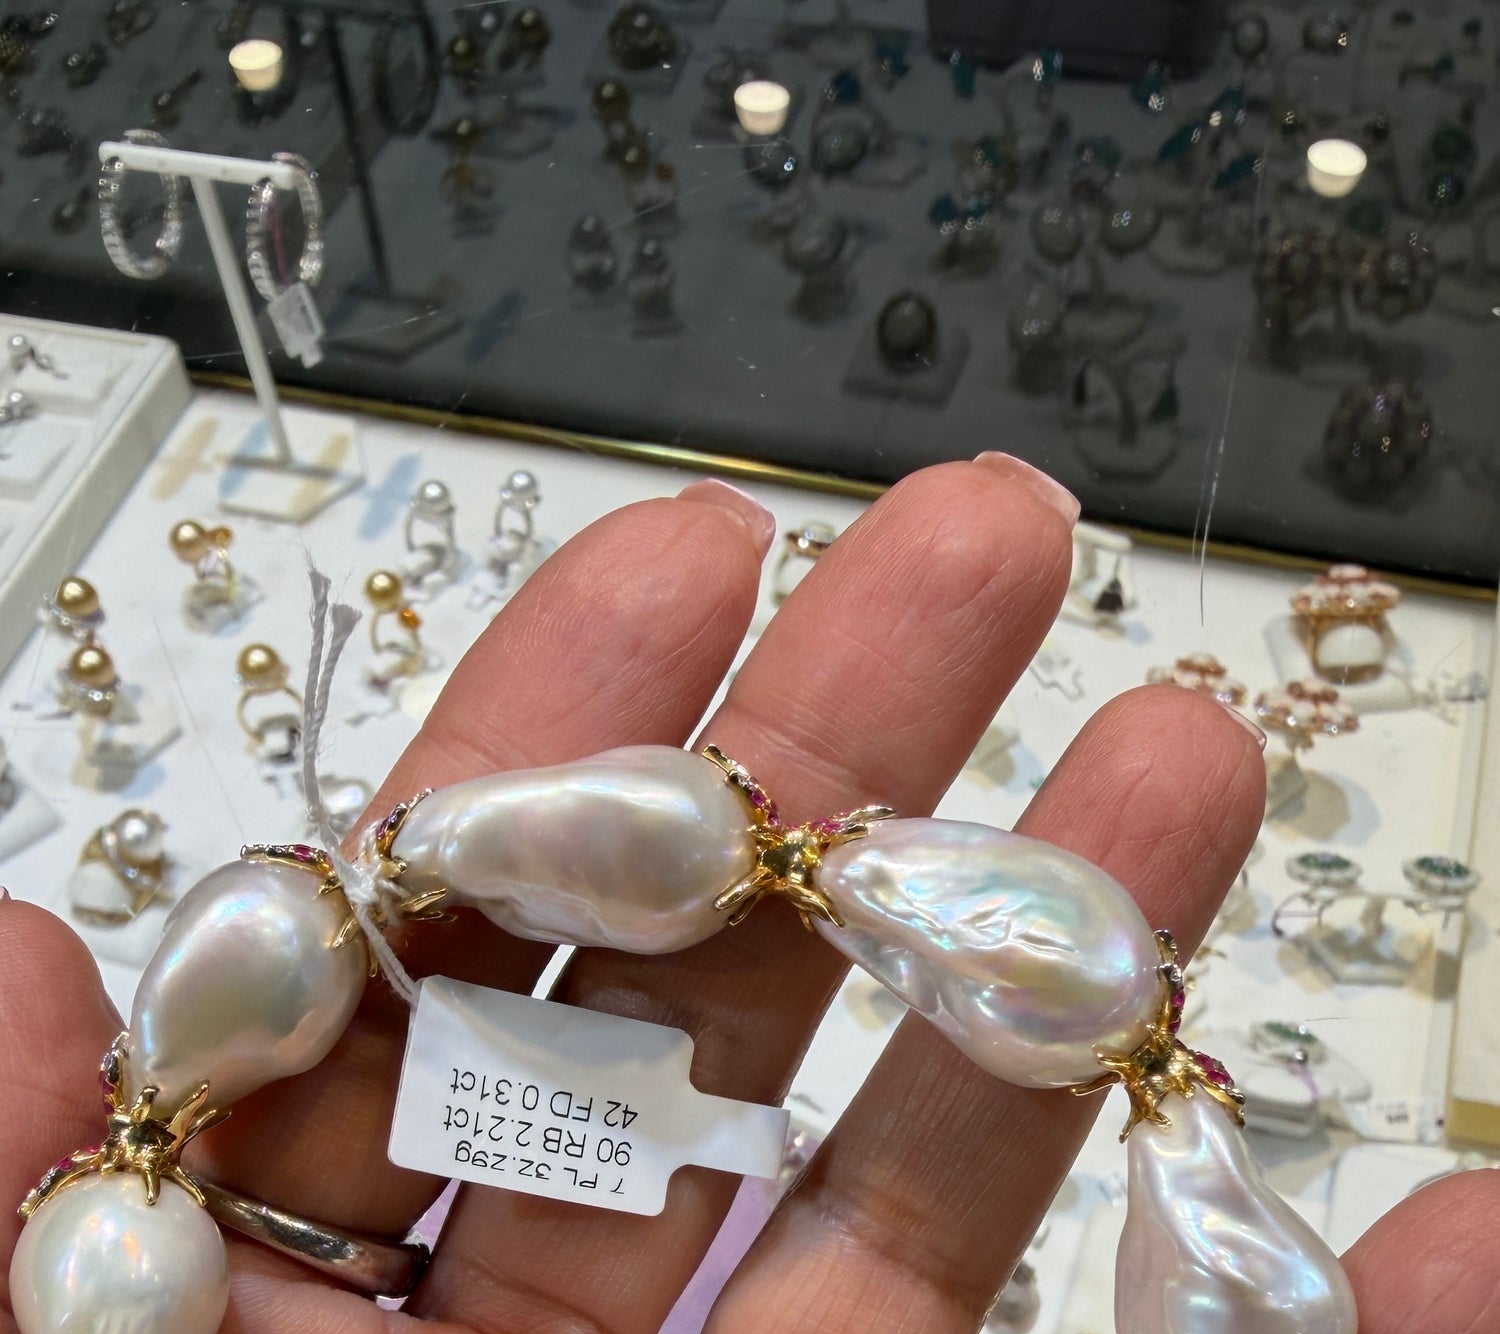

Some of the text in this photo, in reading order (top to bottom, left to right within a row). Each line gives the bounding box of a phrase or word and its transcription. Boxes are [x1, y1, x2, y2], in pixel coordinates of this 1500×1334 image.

[450, 1068, 639, 1130] 42 FD 0.31ct
[443, 1105, 633, 1167] 90 RB 2.21ct
[455, 1140, 625, 1195] 7 PL 32.29g
